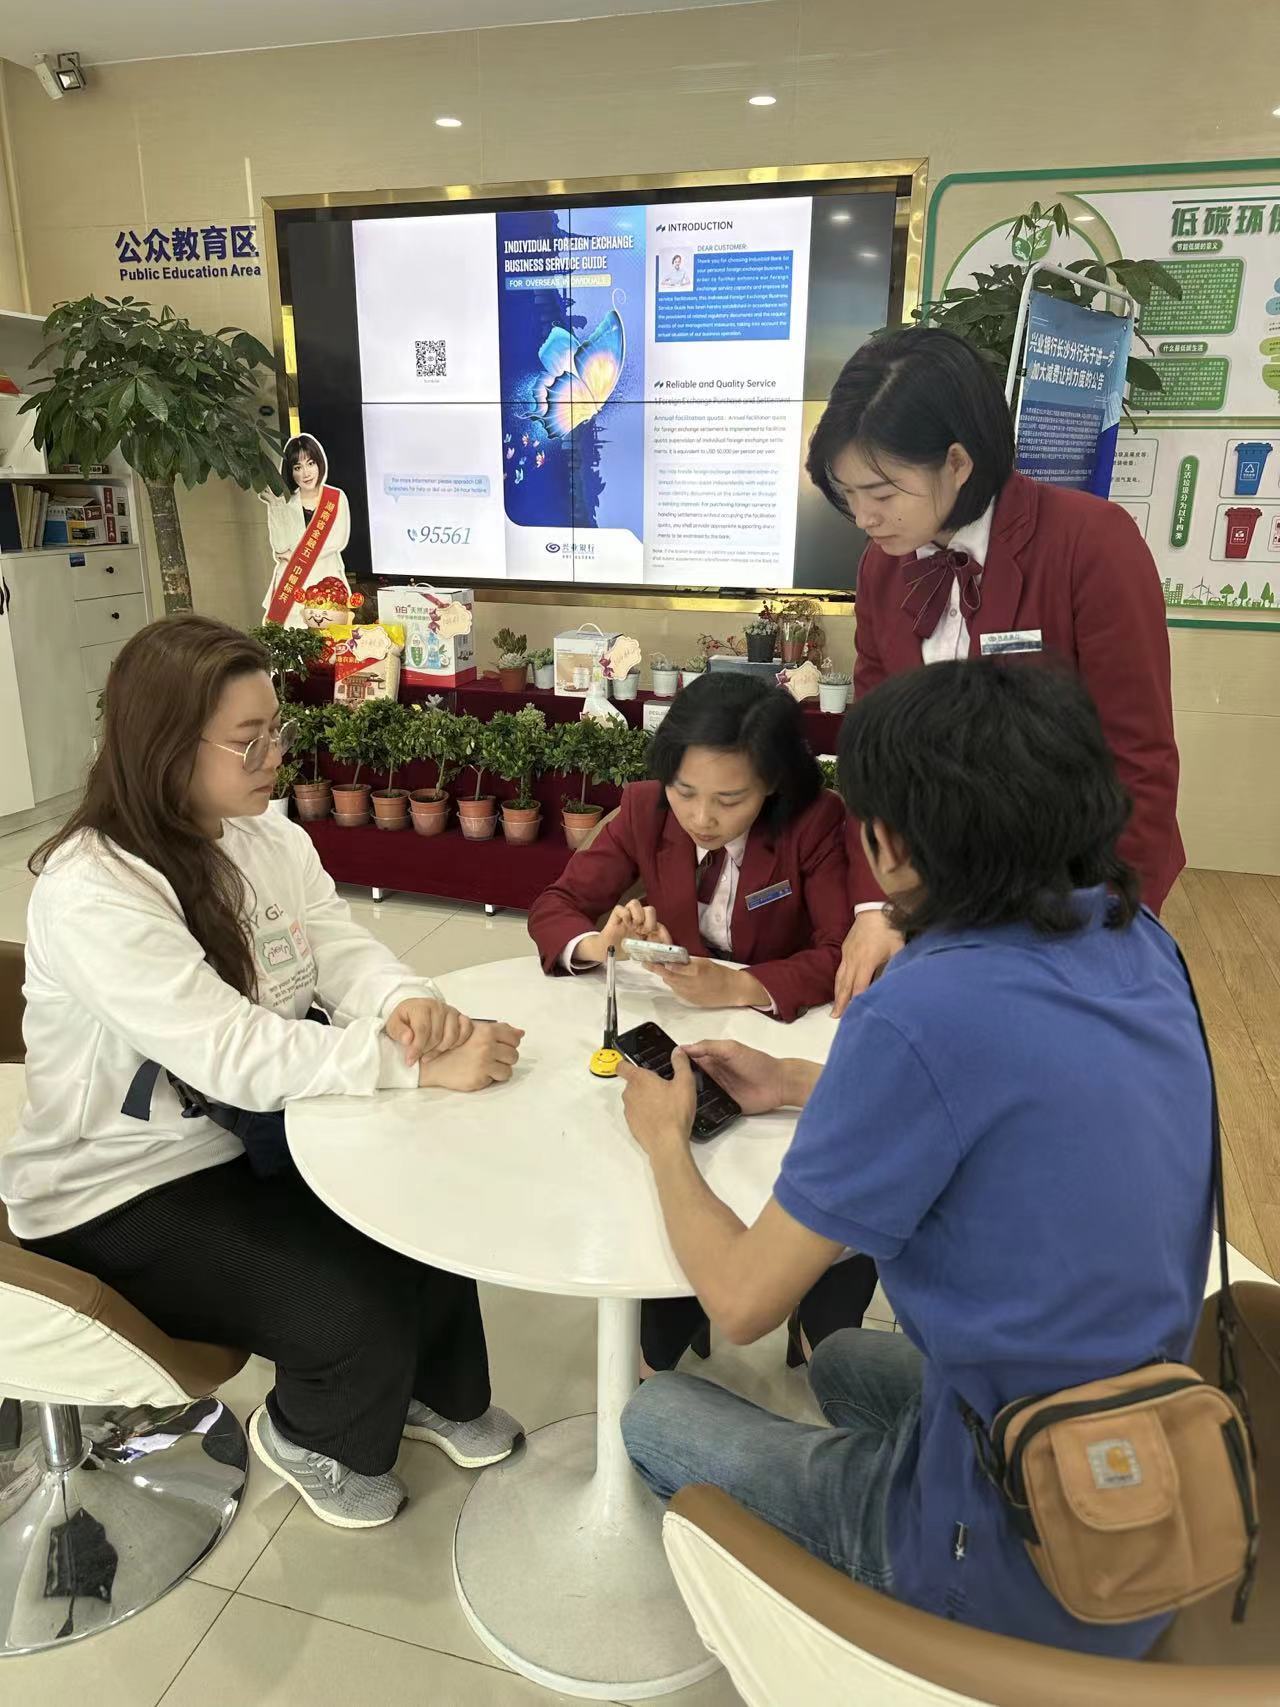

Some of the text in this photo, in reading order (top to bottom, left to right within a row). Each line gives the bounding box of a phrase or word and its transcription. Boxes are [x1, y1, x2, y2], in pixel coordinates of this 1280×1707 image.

[668, 220, 733, 232] INTRODUCTION
[115, 225, 260, 263] 公众教育区
[504, 235, 634, 253] INDIVIDUAL FOREIGN EXCHANGE
[697, 244, 713, 252] DEAR
[120, 263, 261, 281] Public Education Area
[504, 255, 608, 273] BUSINESS SERVICE GUIDE
[509, 279, 523, 288] FOR
[525, 277, 559, 287] OVERSEAS
[1028, 332, 1115, 368] 兴业银行长沙分行关于进一步
[665, 379, 777, 389] Reliable and Quality Service
[1030, 360, 1105, 391] 加大减费让利力度的公告
[1175, 463, 1192, 540] 生活垃圾分为以下四类
[419, 525, 471, 545] 95561
[279, 501, 335, 603] 湖南省金融五一巾帼标兵
